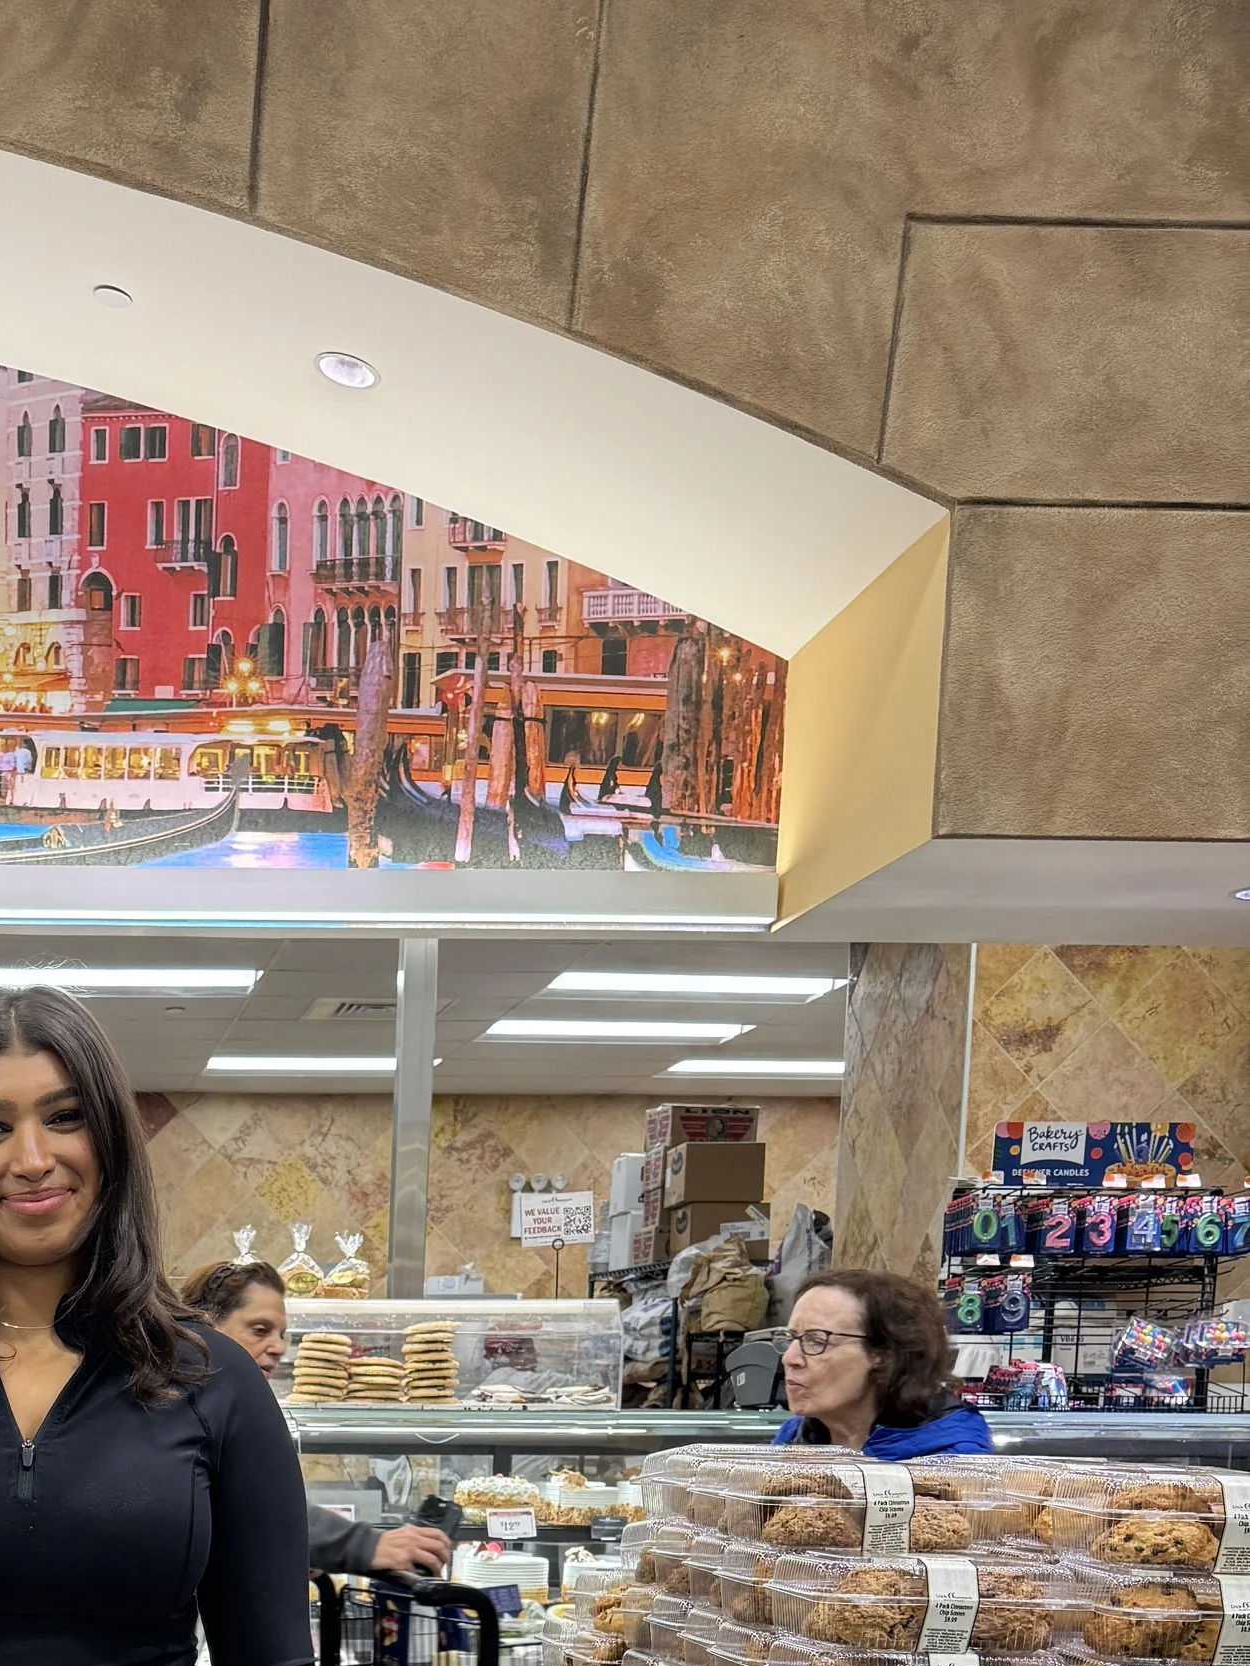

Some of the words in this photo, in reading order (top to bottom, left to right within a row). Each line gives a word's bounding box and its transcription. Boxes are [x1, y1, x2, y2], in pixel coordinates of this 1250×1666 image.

[685, 1108, 750, 1116] LION
[1026, 1125, 1082, 1150] Bakery
[1031, 1141, 1070, 1152] CRAFTS
[1053, 1168, 1090, 1178] CANDLES
[524, 1208, 536, 1217] WE
[537, 1206, 561, 1216] VALUE
[532, 1216, 553, 1225] YOUR
[523, 1225, 562, 1235] FEEDBACK
[1045, 1213, 1072, 1248] 2
[1087, 1212, 1112, 1247] 3
[1196, 1212, 1221, 1245] 6
[957, 1293, 981, 1324] 8
[1000, 1290, 1026, 1323] 9
